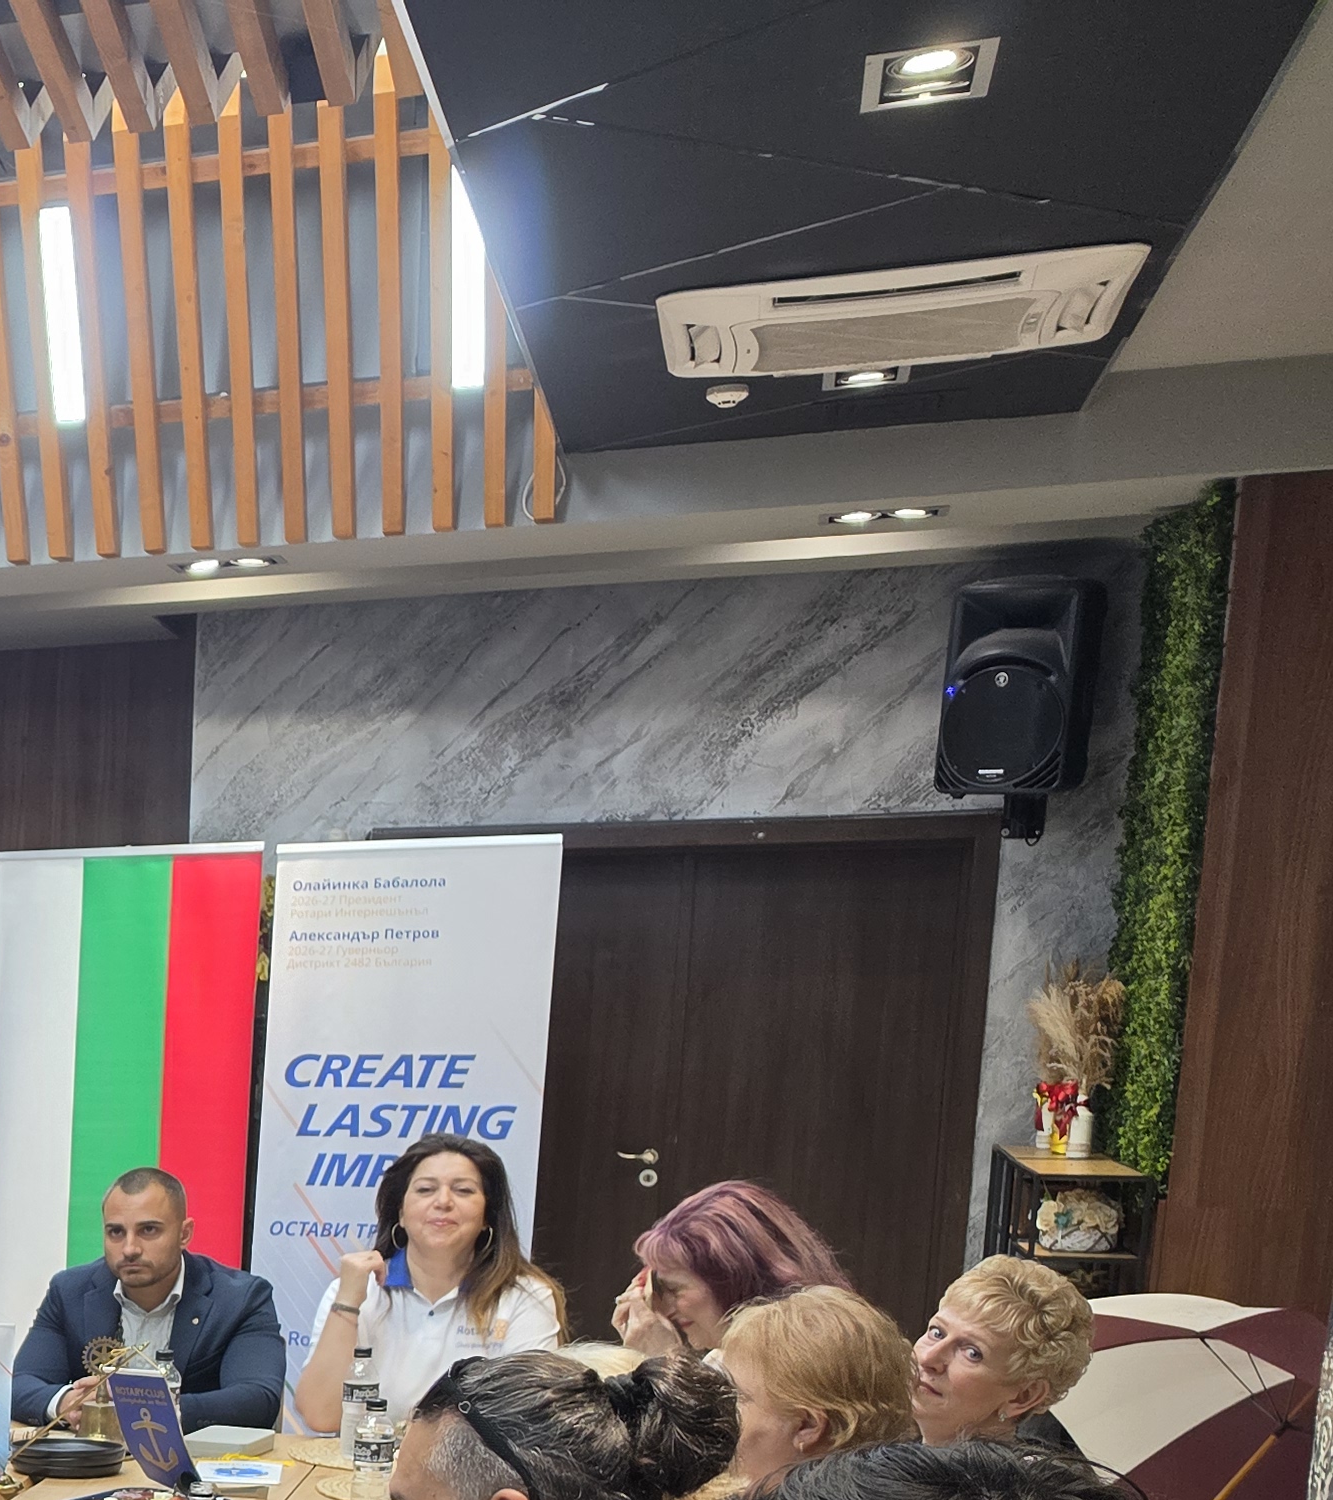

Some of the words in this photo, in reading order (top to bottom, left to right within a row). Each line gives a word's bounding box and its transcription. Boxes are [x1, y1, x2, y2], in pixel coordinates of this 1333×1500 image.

[293, 878, 369, 892] Олайинка
[374, 876, 447, 889] Бабалола
[339, 894, 402, 907] Президент
[290, 909, 332, 921] Ротари
[289, 930, 380, 943] Александър
[384, 928, 440, 942] Петров
[286, 958, 340, 970] Дистрикт
[344, 957, 372, 968] 2482
[375, 956, 433, 970] България
[284, 1053, 476, 1089] CREATE
[296, 1103, 518, 1141] LASTING
[305, 1153, 396, 1188] IMP
[269, 1220, 350, 1238] ОСТАВИ
[356, 1223, 378, 1239] ТР
[288, 1330, 312, 1347] Ro
